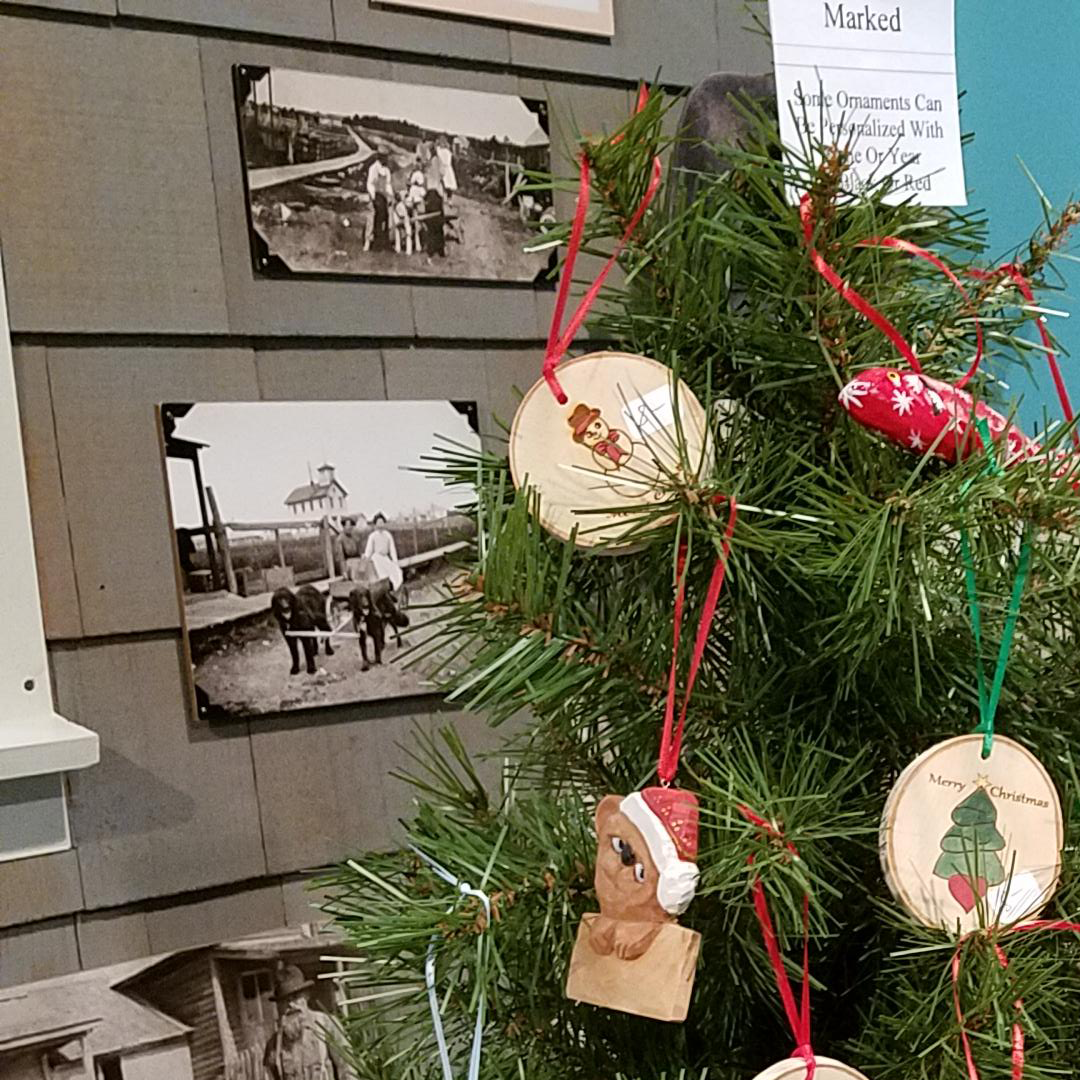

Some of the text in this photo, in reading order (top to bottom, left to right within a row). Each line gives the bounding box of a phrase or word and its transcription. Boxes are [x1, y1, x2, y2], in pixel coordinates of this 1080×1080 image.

[824, 2, 901, 32] Marked
[793, 87, 943, 111] Some Ornaments Can
[909, 119, 944, 138] With
[865, 146, 882, 163] Or
[903, 174, 932, 192] Red
[928, 773, 1050, 808] Merry Christmas
